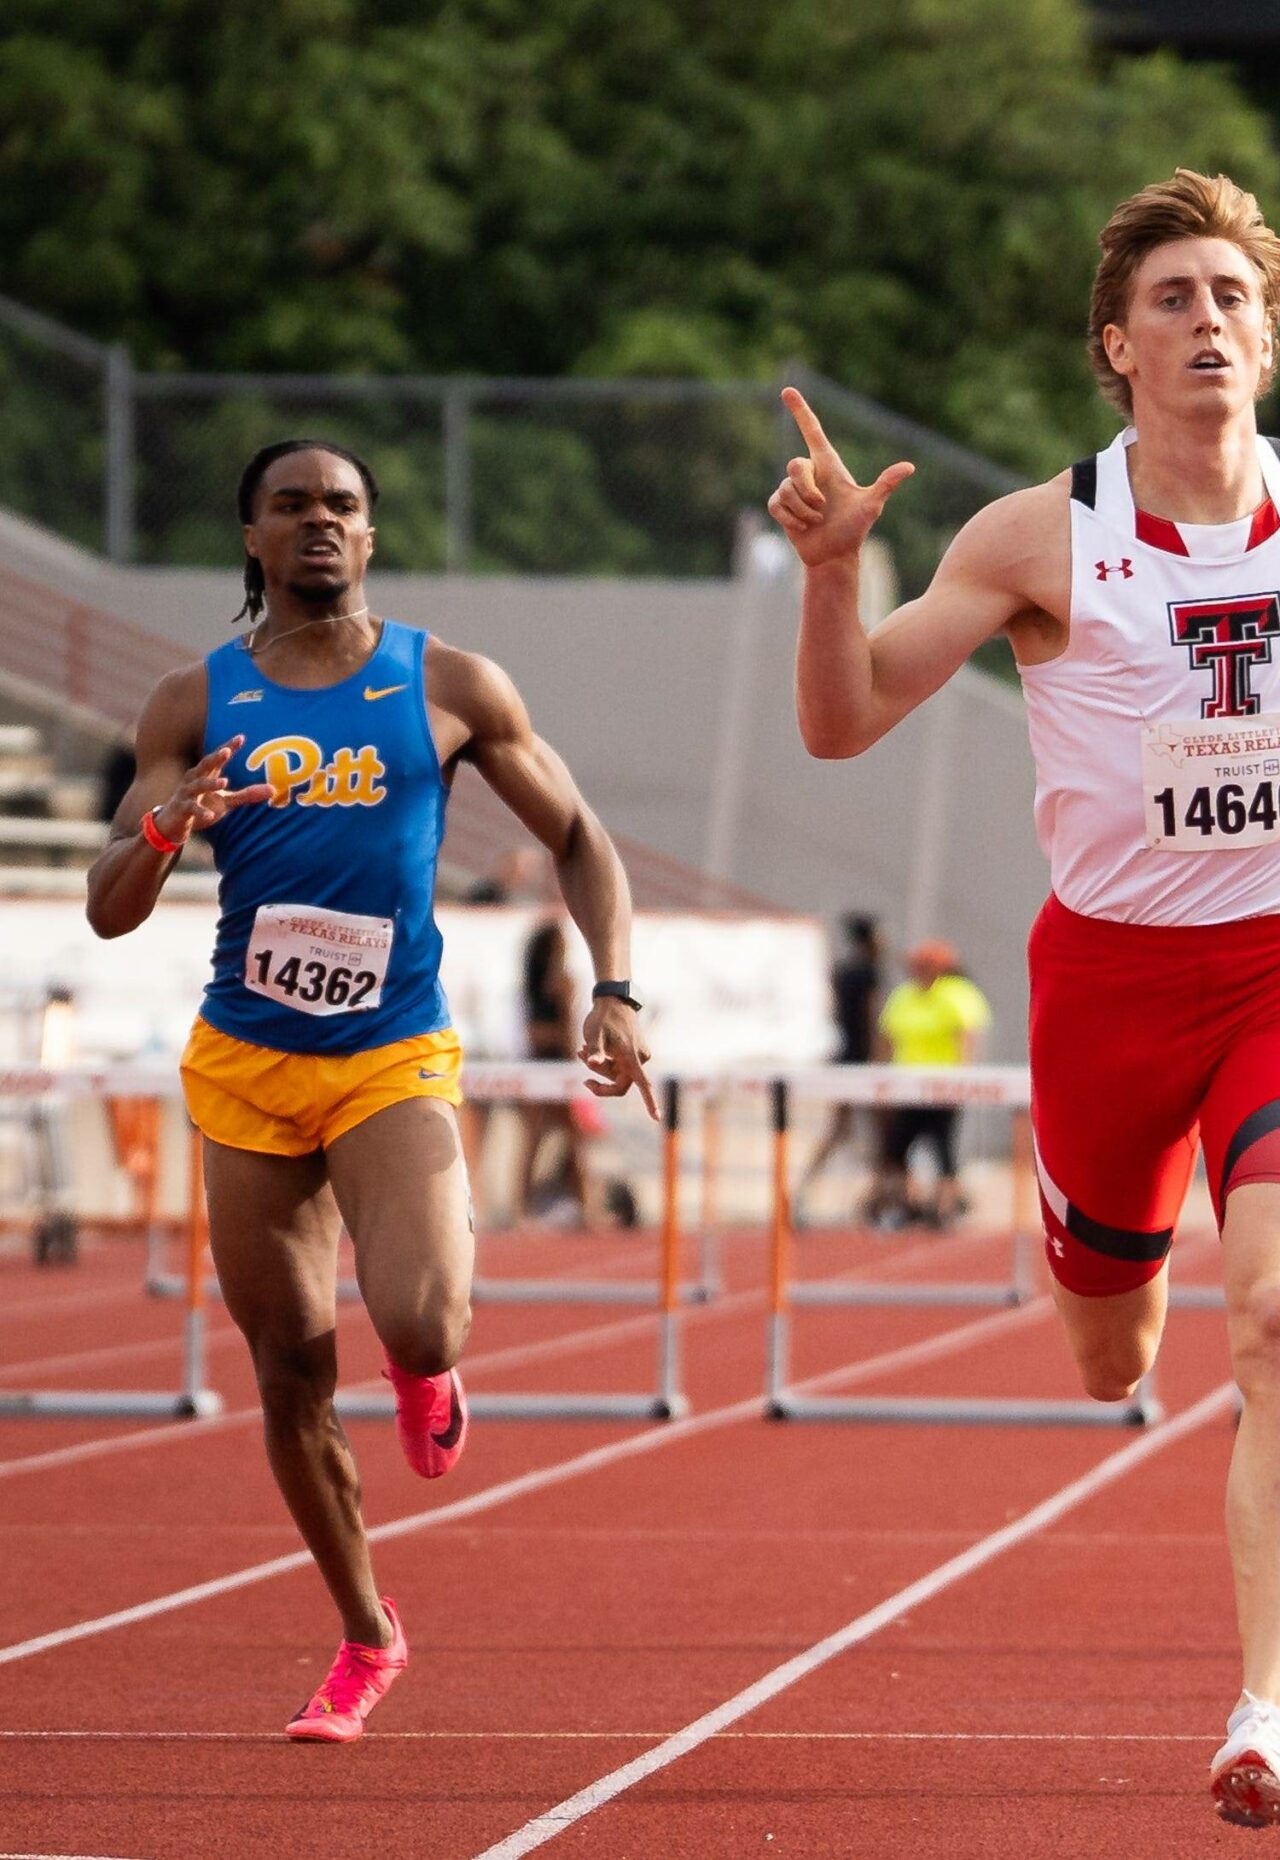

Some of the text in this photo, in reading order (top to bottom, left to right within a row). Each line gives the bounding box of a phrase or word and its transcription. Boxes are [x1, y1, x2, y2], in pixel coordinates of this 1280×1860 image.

[1183, 734, 1223, 744] CLYDE
[1183, 741, 1241, 757] TEXAS
[246, 735, 387, 808] Pitt
[1214, 764, 1260, 778] TRUIST
[289, 923, 336, 942] TEXAS
[339, 933, 388, 949] RELAYS
[309, 946, 347, 961] TRUIST
[254, 949, 377, 1008] 14362
